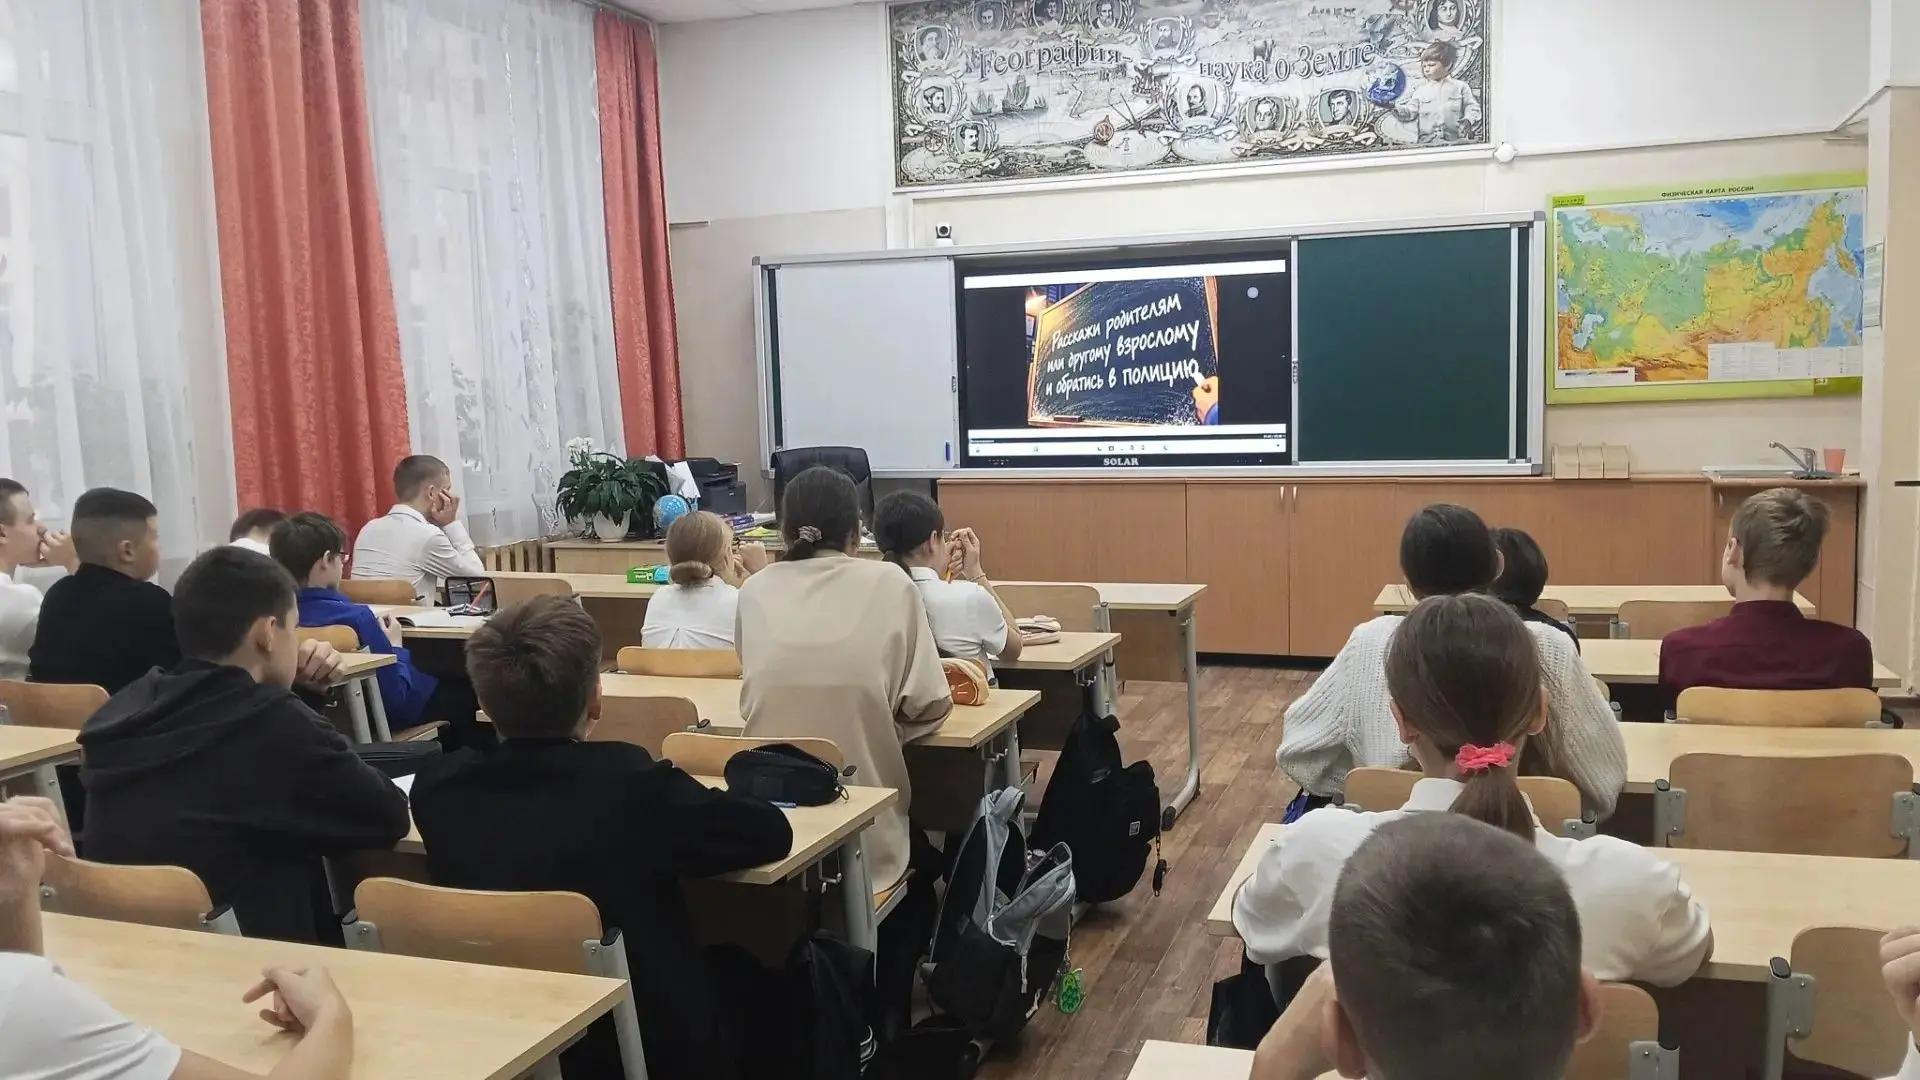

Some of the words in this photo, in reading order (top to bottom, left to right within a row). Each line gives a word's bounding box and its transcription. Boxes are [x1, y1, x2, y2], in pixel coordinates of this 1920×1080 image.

[978, 39, 1121, 81] География
[1199, 60, 1268, 86] наука
[1275, 59, 1291, 80] о
[1296, 43, 1377, 79] Земле
[1661, 189, 1703, 197] ФИЗИЧЕСКАЯ
[1051, 324, 1101, 352] Расскажи
[1106, 293, 1181, 338] родителям
[1047, 357, 1065, 373] или
[1068, 345, 1111, 372] другому
[1116, 320, 1200, 359] взрослому
[1045, 381, 1053, 396] и
[1056, 375, 1104, 400] обратись
[1122, 358, 1199, 388] полицию
[1103, 457, 1139, 466] SOLAR
